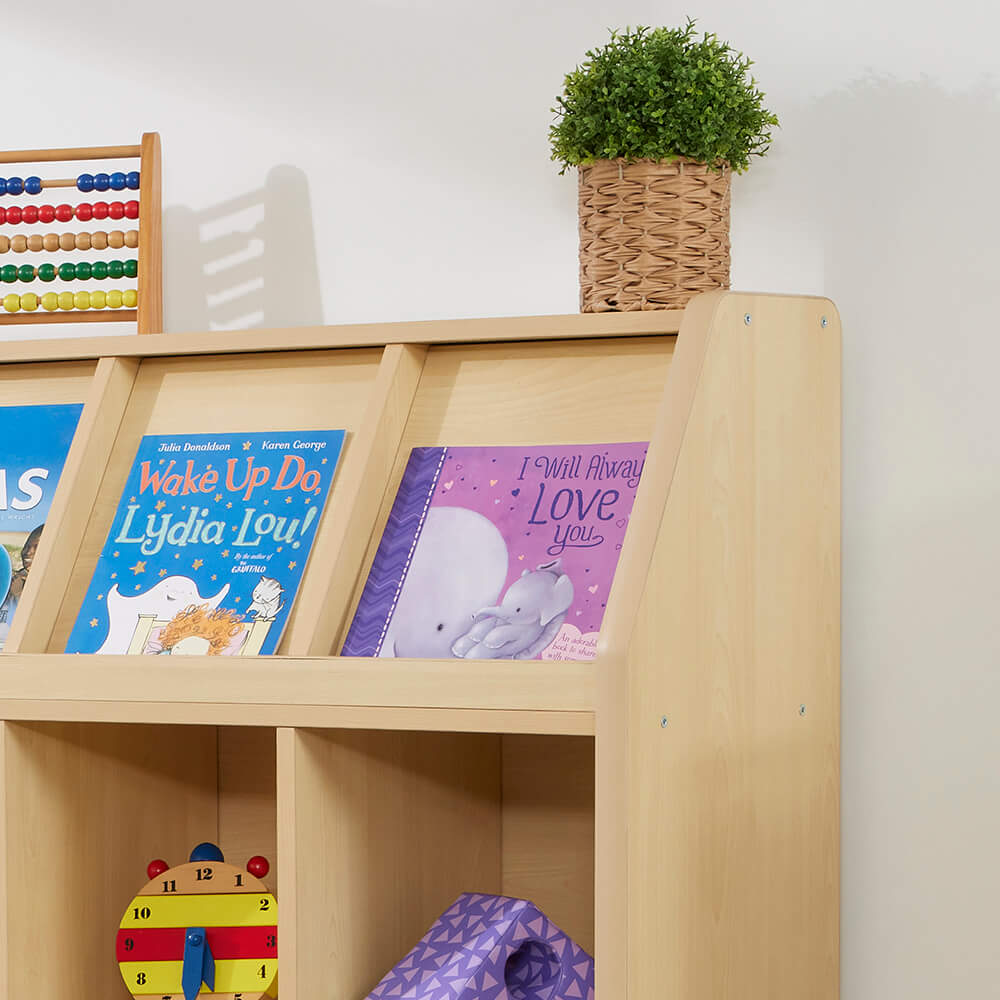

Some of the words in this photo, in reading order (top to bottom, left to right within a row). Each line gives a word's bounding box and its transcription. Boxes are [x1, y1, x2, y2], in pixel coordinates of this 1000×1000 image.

[158, 443, 181, 453] Julia
[184, 442, 230, 452] Donaldson
[262, 440, 290, 450] Karen
[293, 440, 327, 452] George
[139, 459, 219, 496] Wake
[225, 456, 270, 501] Up
[272, 454, 321, 496] Do,
[517, 456, 531, 480] I
[534, 455, 582, 480] Will
[585, 454, 646, 489] Alway
[115, 504, 226, 556] Lydia
[232, 505, 318, 550] Lou!
[546, 523, 605, 556] you
[571, 637, 598, 648] adorabl
[196, 868, 213, 881] 12
[234, 874, 243, 887] 1
[162, 880, 177, 892] 11
[260, 899, 270, 911] 2
[133, 907, 151, 919] 10
[125, 938, 134, 951] 9
[266, 936, 276, 948] 3
[257, 964, 267, 978] 4
[136, 973, 146, 985] 8
